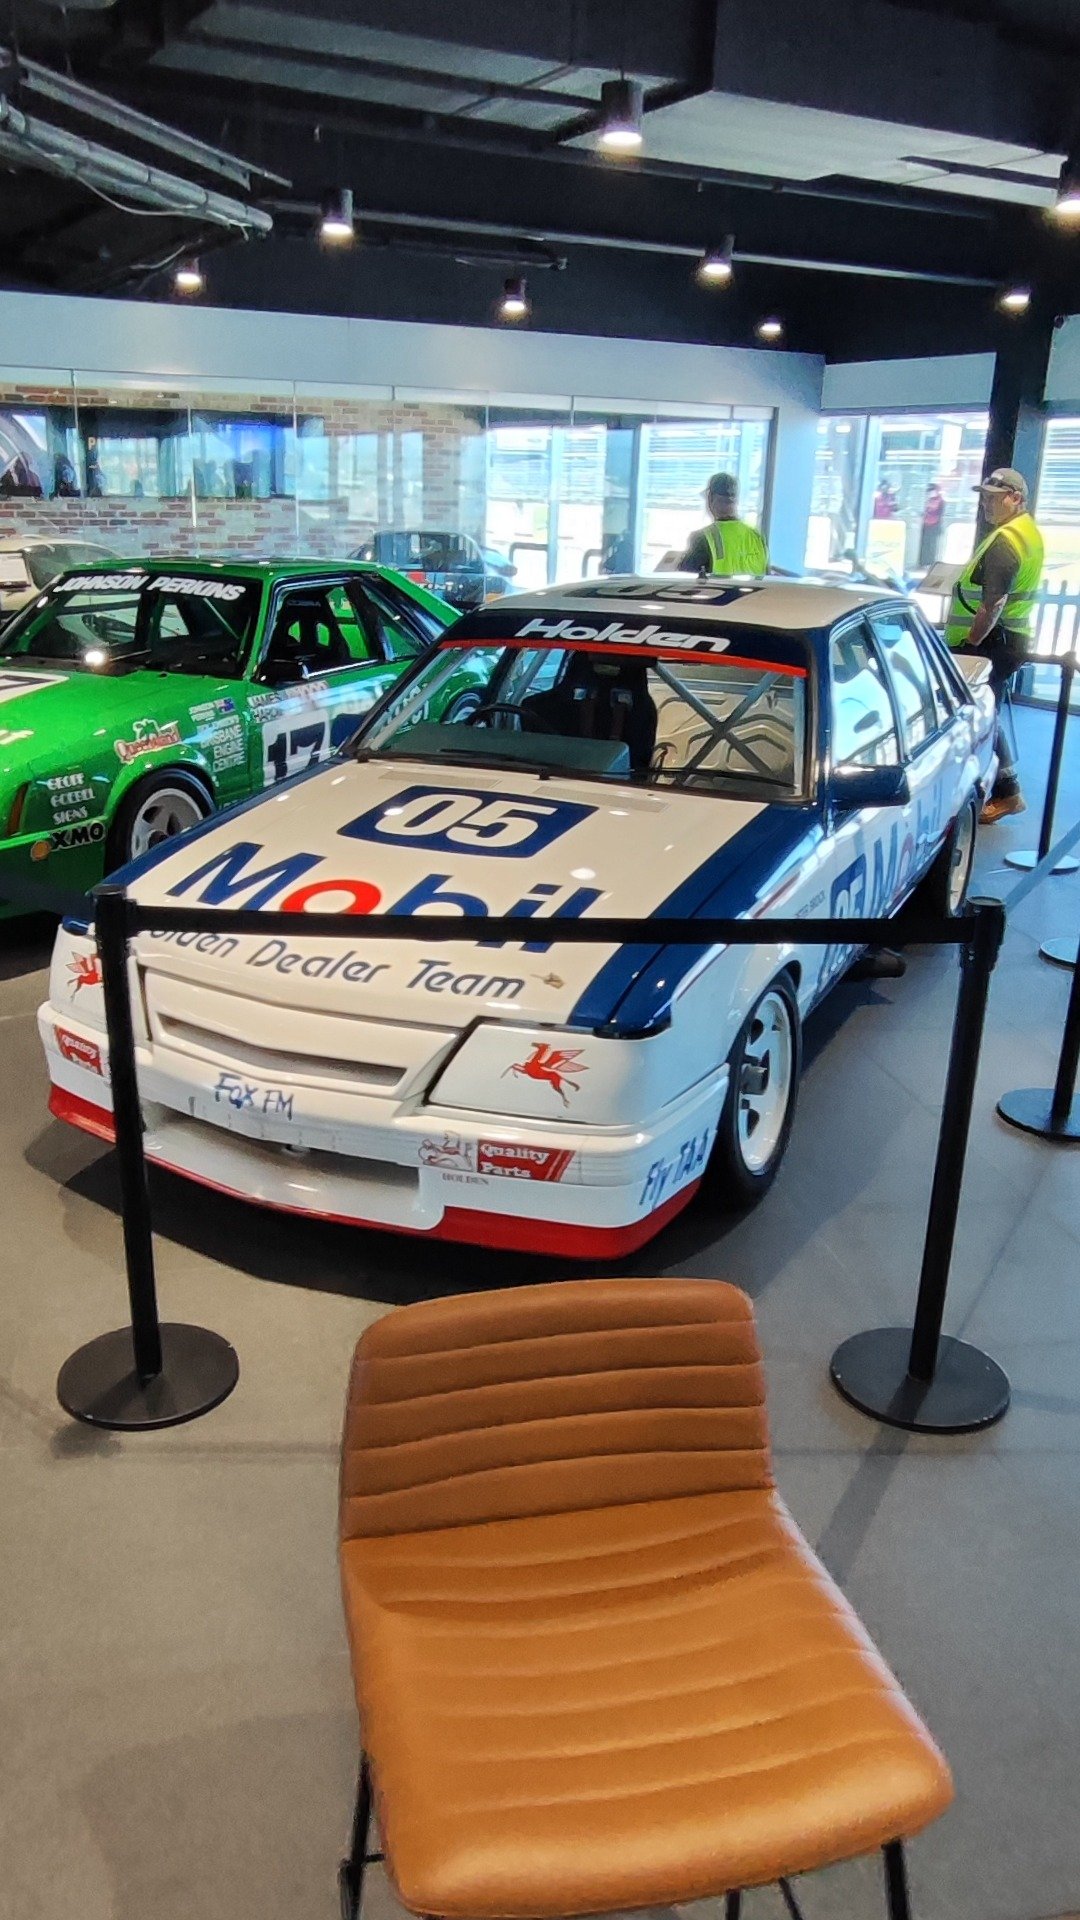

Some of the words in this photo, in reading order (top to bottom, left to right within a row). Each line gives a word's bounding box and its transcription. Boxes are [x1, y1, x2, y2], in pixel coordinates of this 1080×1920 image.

[53, 575, 149, 593] JOHNSON
[147, 576, 247, 601] PERKINS
[596, 583, 732, 600] 05
[514, 618, 731, 652] Holden
[267, 722, 326, 780] 17
[53, 805, 88, 825] SIGNS
[374, 794, 560, 847] 05
[51, 822, 105, 848] XMO
[165, 842, 605, 953] Mobil
[246, 938, 391, 984] Dealer
[406, 958, 526, 999] Team
[262, 1089, 294, 1121] FM
[480, 1143, 550, 1165] Quality
[442, 1173, 489, 1185] HOLDEN
[480, 1161, 531, 1178] Parts
